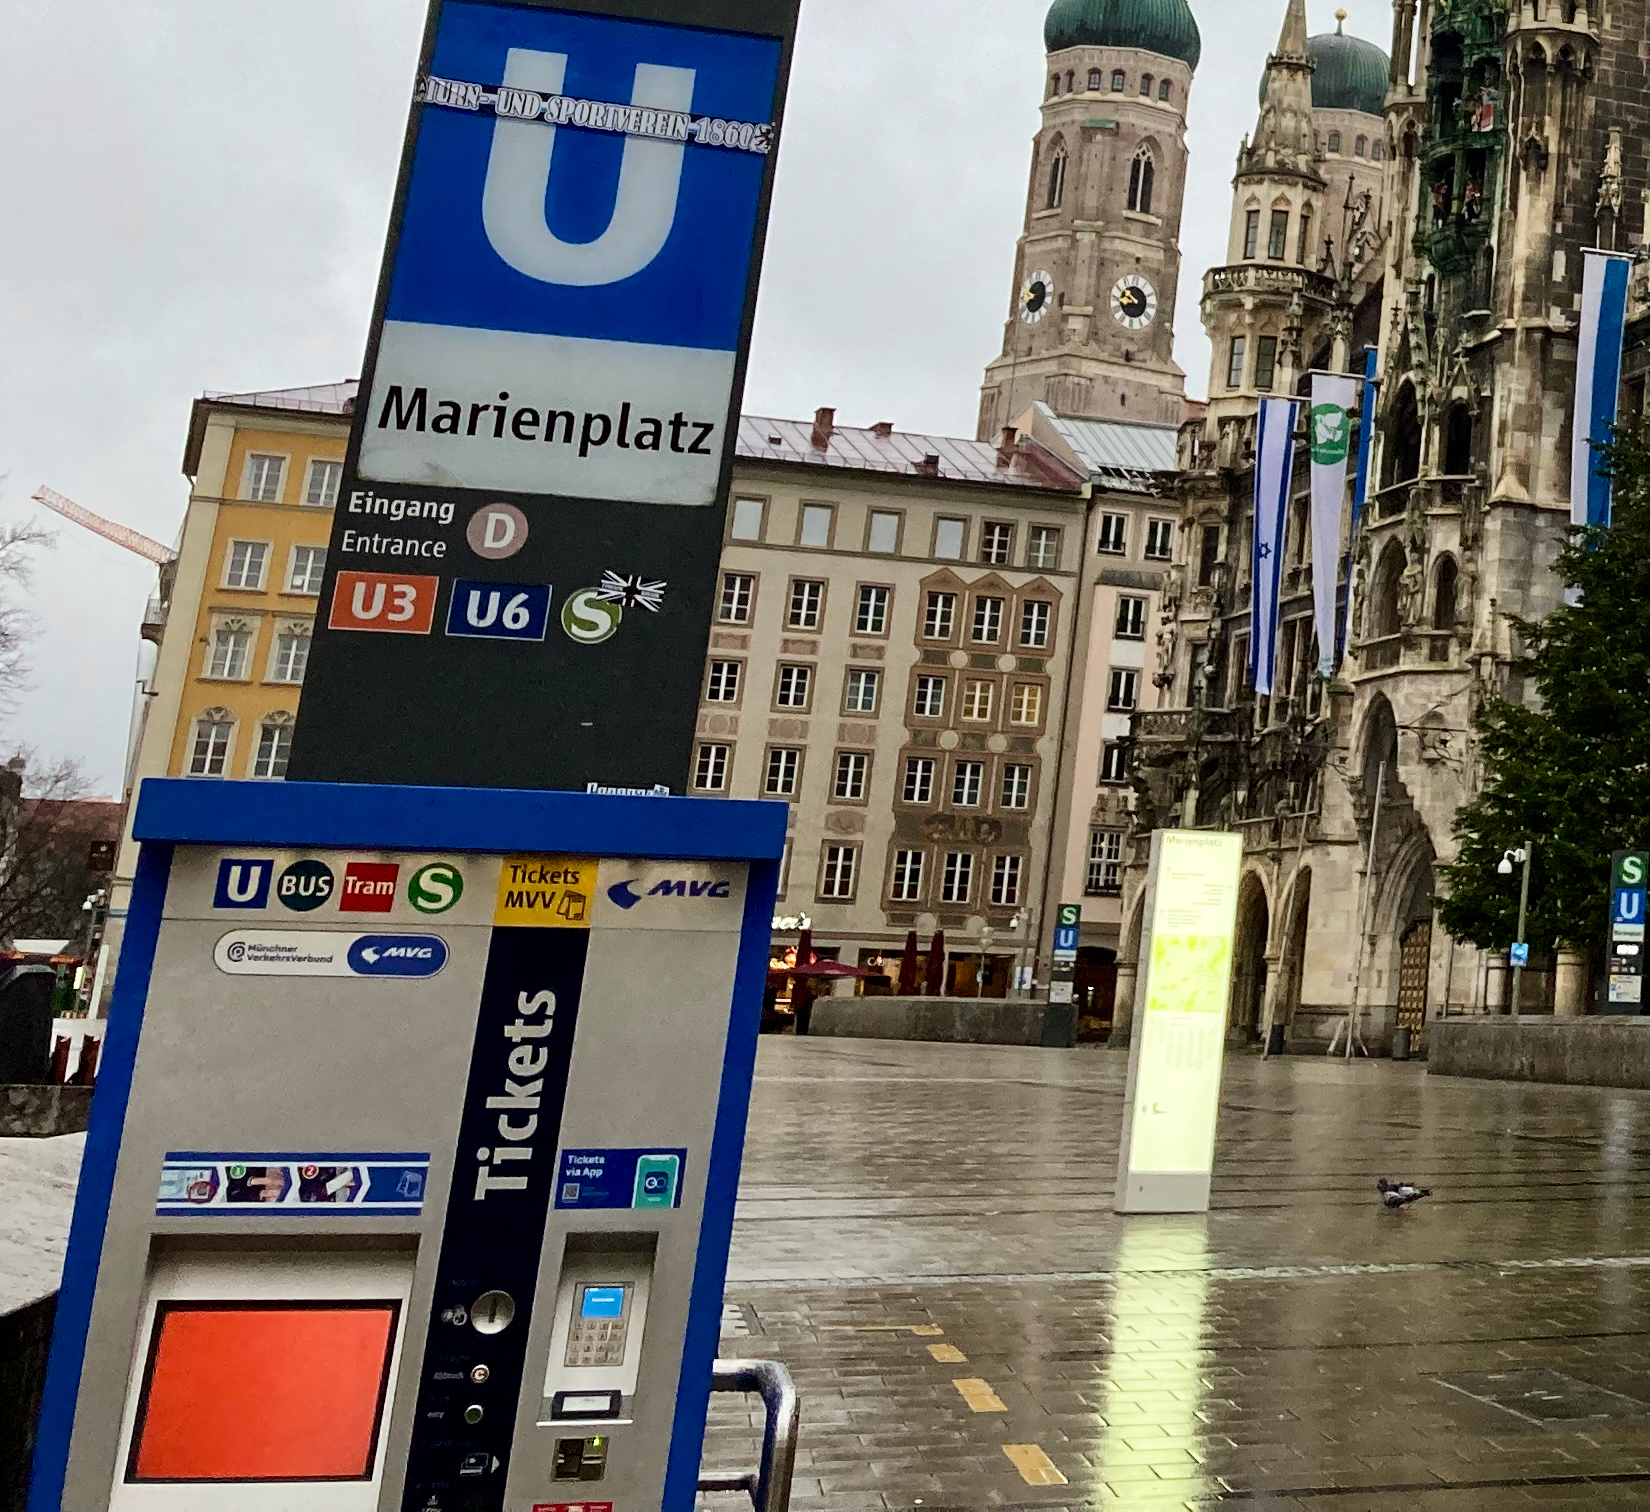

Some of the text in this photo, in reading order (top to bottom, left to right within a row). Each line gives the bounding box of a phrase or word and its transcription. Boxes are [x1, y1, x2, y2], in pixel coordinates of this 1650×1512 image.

[482, 48, 696, 287] U
[377, 385, 715, 458] Marienplatz
[348, 491, 455, 525] Eingang
[484, 512, 515, 548] D
[341, 530, 447, 558] Entrance
[351, 582, 612, 638] U3 U6 S
[508, 864, 580, 885] Tickets
[1622, 856, 1642, 884] S
[227, 865, 454, 910] U BUS Tram S
[505, 890, 556, 909] MVV
[648, 879, 731, 899] MVG
[1062, 907, 1077, 925] S
[1620, 892, 1639, 919] U
[1060, 930, 1074, 947] U
[382, 946, 432, 959] MVG
[474, 989, 556, 1201] Tickets
[565, 1167, 604, 1179] via App
[568, 1155, 605, 1164] Tickets
